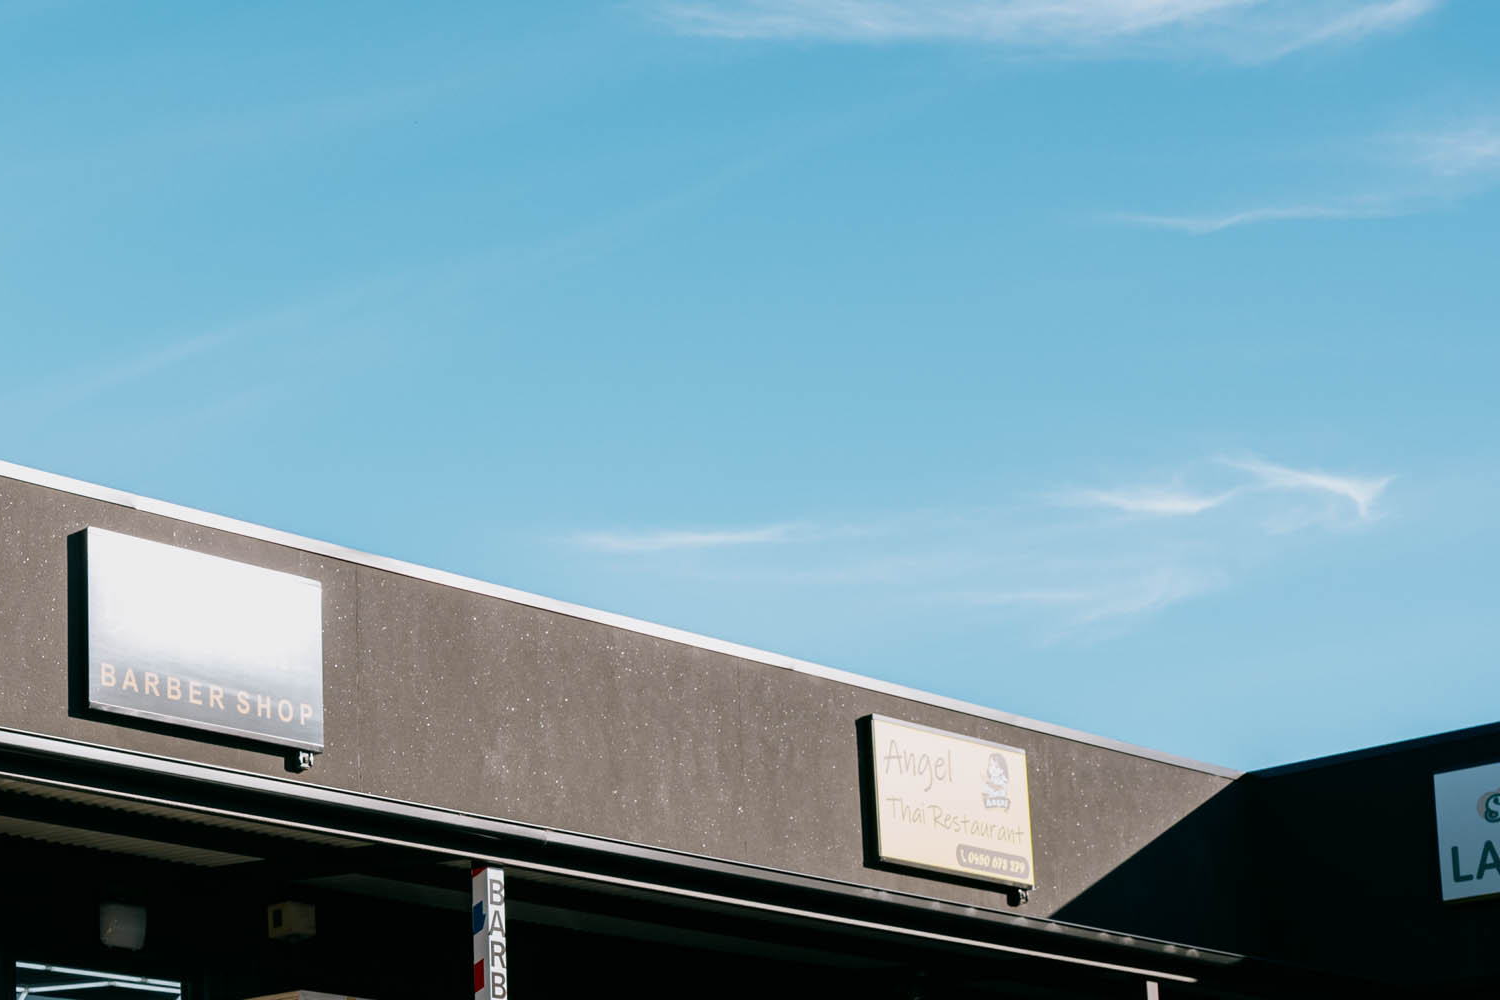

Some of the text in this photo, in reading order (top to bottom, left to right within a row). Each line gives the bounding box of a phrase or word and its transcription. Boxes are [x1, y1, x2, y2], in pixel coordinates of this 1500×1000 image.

[100, 662, 314, 725] BARBER SHOP
[883, 739, 953, 792] Angel
[886, 797, 1025, 846] Thai Restaurant
